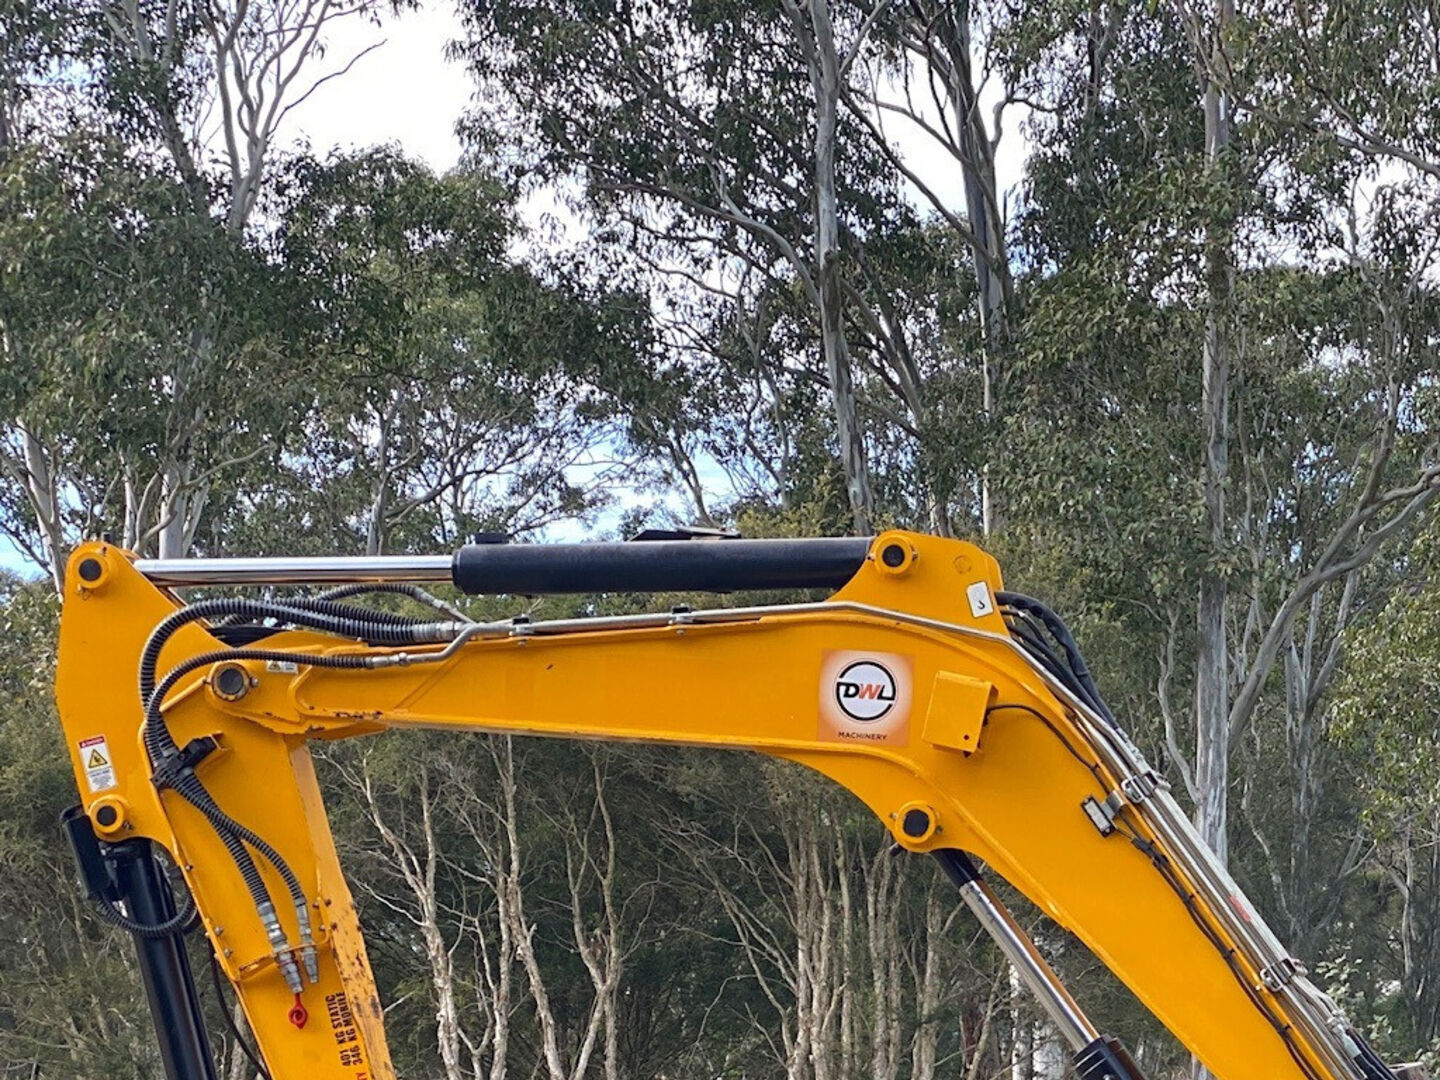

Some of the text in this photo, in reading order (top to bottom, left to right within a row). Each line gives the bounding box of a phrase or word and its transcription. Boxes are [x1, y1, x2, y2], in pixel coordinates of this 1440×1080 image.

[836, 682, 895, 701] DWL
[838, 731, 888, 741] MACHINERY
[325, 995, 353, 1067] 401 KG STATIC
[346, 1028, 357, 1042] KG
